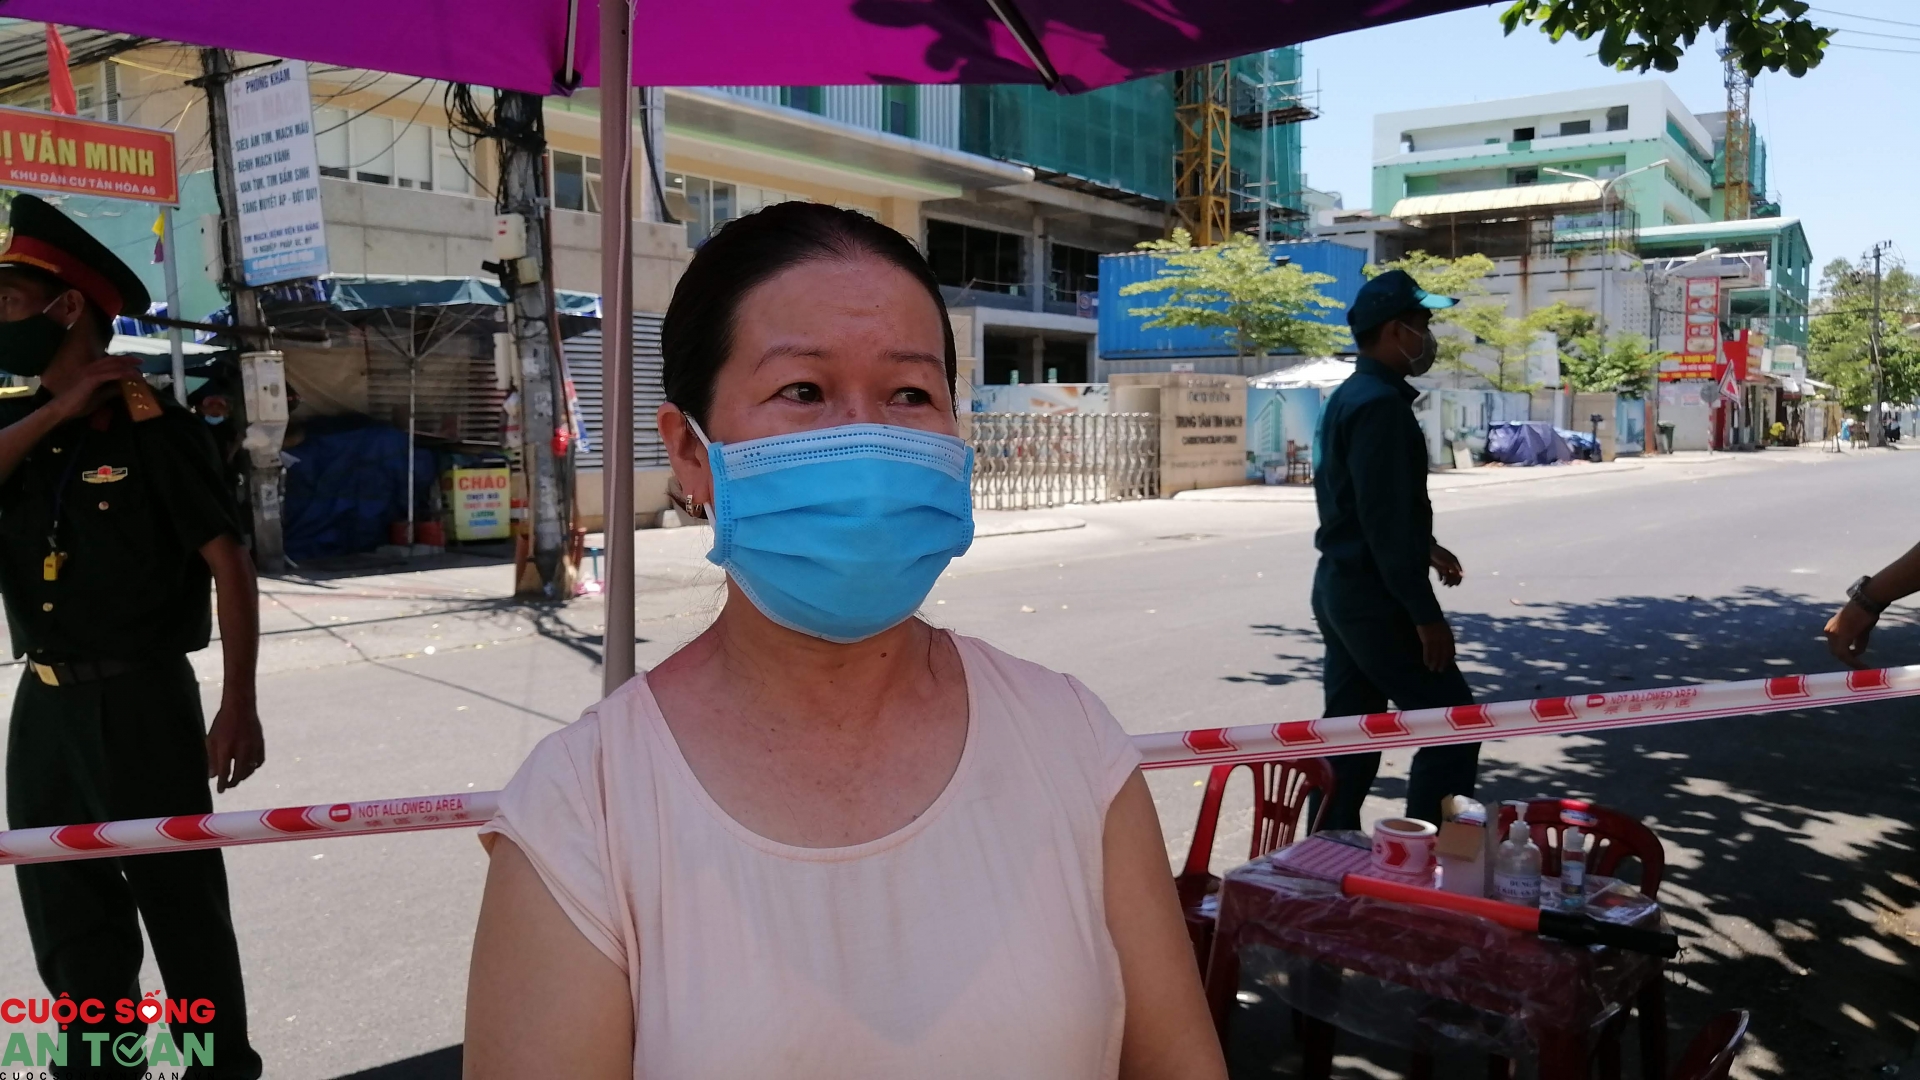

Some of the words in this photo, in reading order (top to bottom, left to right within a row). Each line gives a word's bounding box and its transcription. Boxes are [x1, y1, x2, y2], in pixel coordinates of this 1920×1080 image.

[19, 129, 77, 167] VĂN
[84, 141, 155, 177] MINH
[10, 169, 37, 182] KHU
[40, 171, 67, 185] DÂN
[88, 177, 113, 191] TÂN
[1611, 694, 1628, 705] NOT
[1630, 691, 1673, 703] ALLOWED
[1674, 688, 1697, 699] AREA
[358, 804, 379, 818] NOT
[382, 801, 432, 816] ALLOWED
[436, 798, 464, 812] AREA
